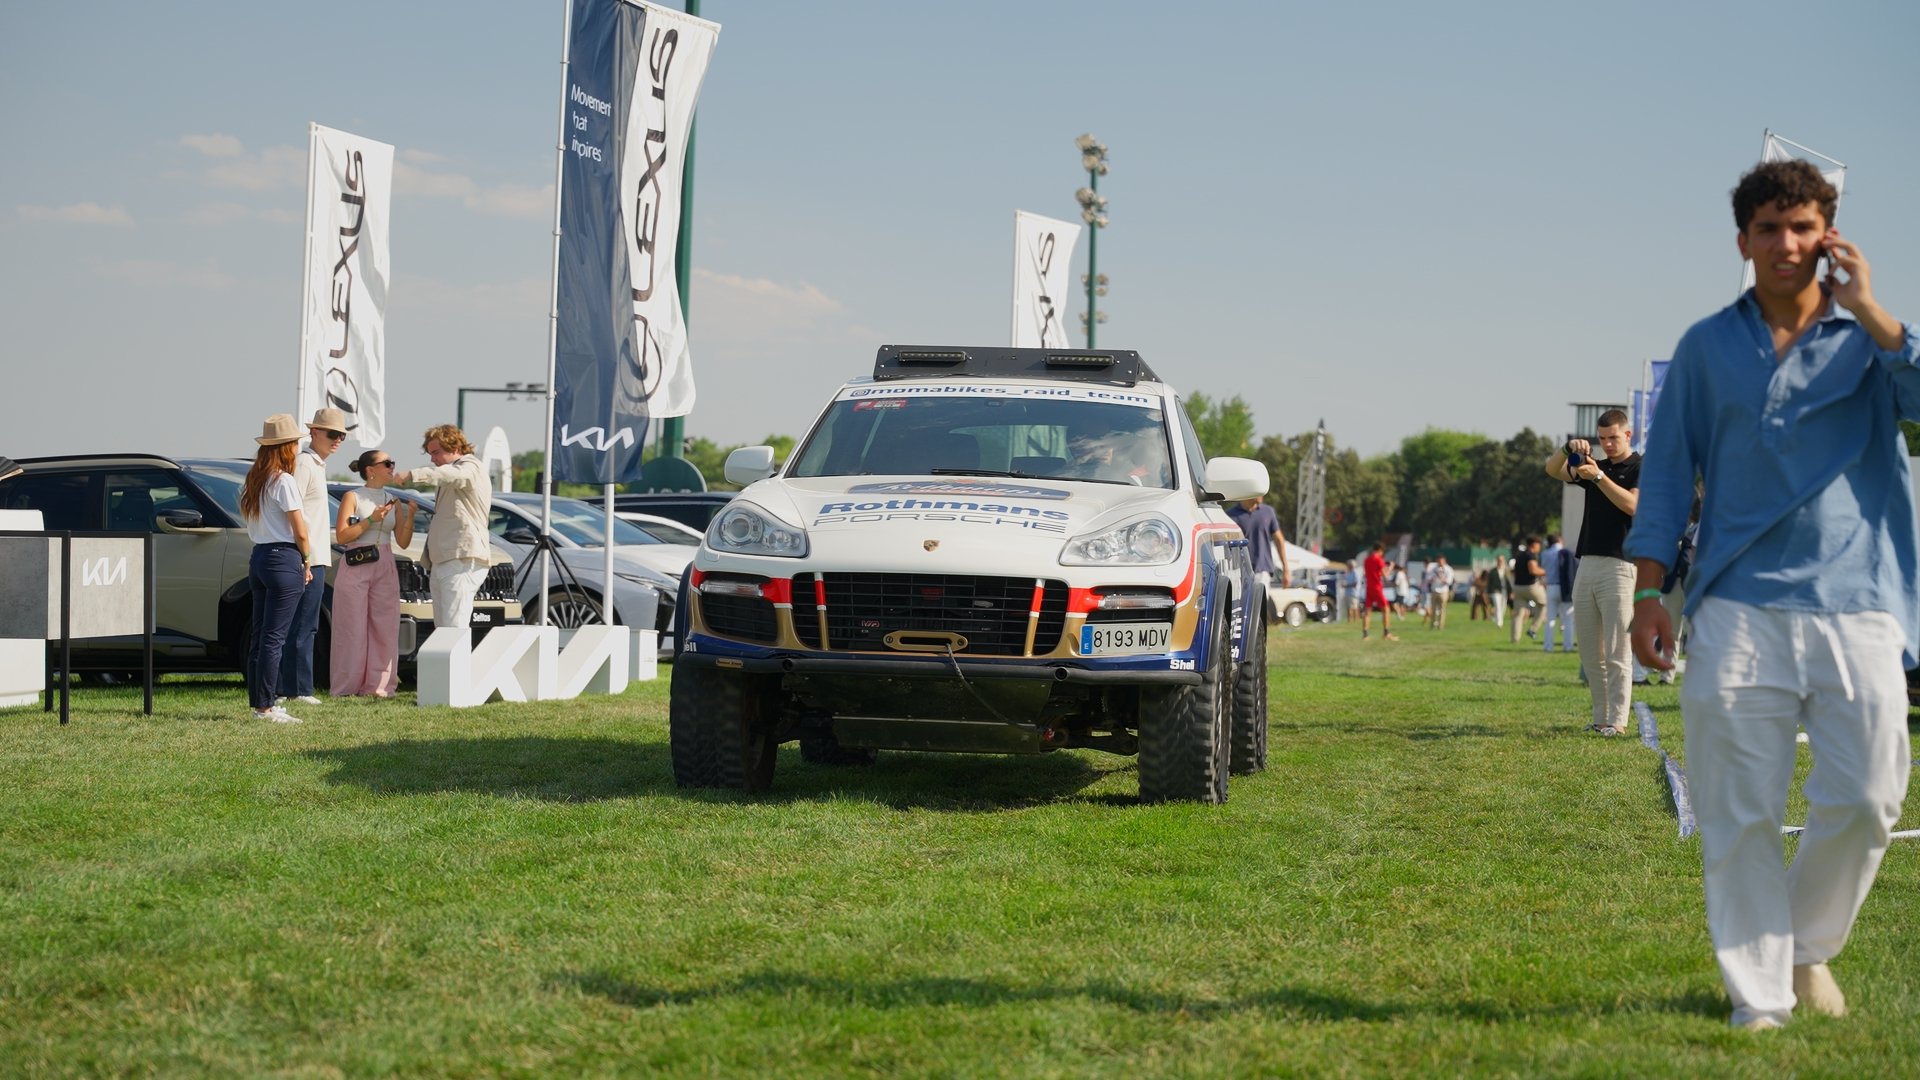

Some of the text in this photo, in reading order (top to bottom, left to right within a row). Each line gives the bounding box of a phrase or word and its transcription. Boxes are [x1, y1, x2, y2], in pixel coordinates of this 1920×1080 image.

[572, 110, 588, 132] hat
[631, 27, 679, 301] LEXUS
[328, 149, 366, 360] LEXUS
[850, 386, 1148, 403] @momabikes_raid_team
[561, 423, 635, 452] KIA
[819, 499, 1070, 521] Rothmans
[813, 512, 1067, 534] PORSCHE
[82, 557, 127, 587] KIA
[1093, 630, 1134, 648] 8193
[1138, 629, 1169, 647] MDV
[1169, 659, 1195, 670] Shell
